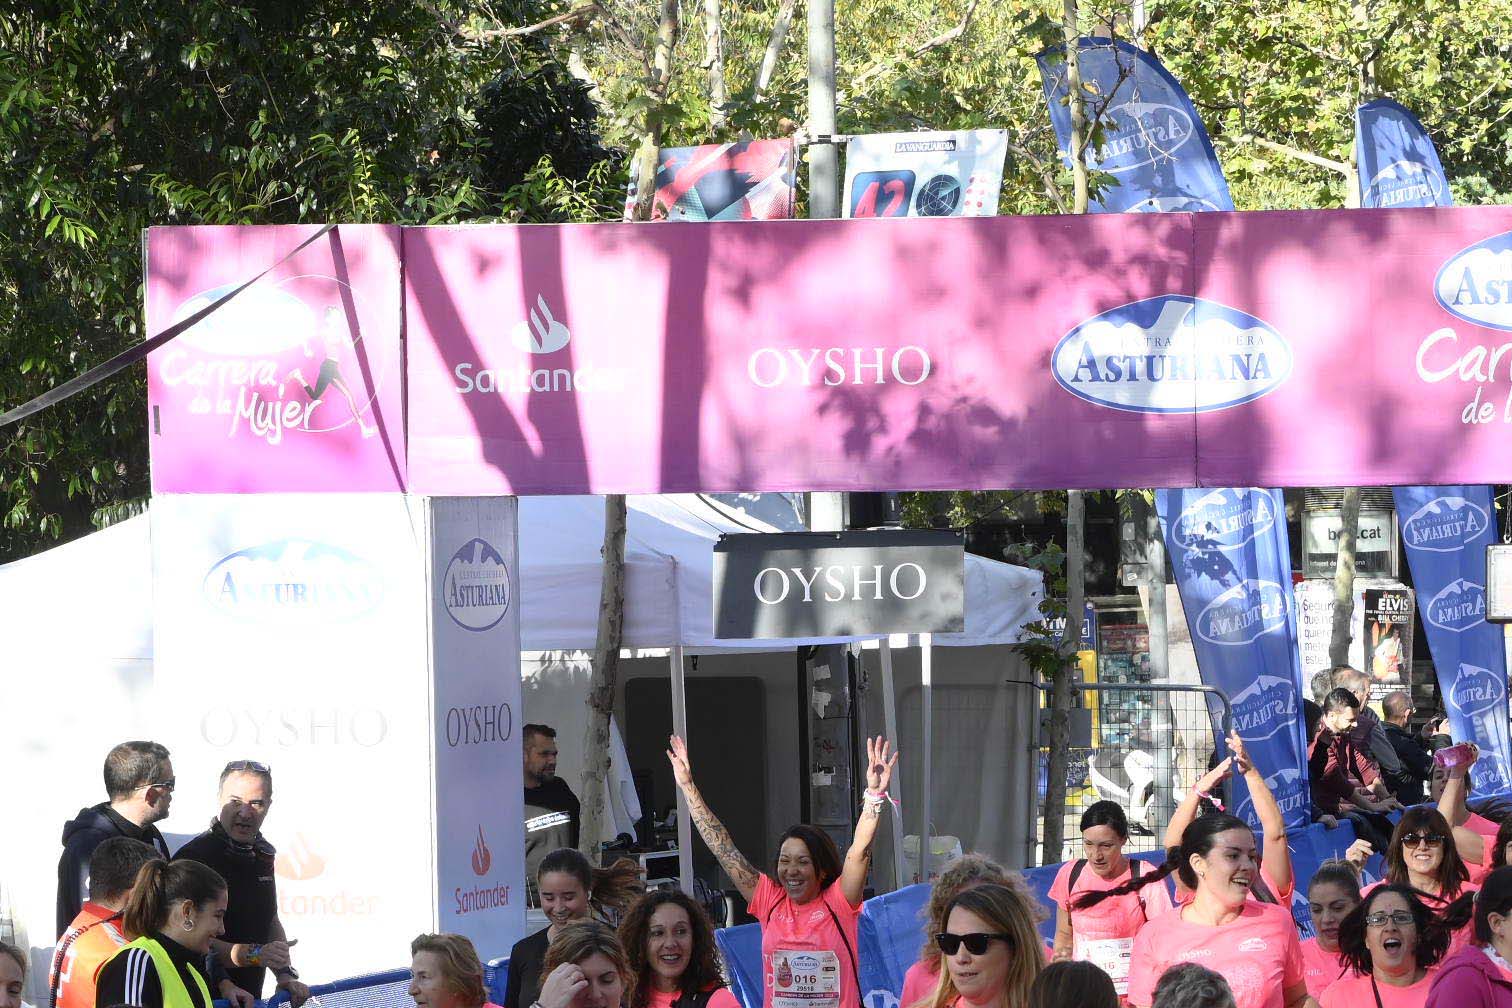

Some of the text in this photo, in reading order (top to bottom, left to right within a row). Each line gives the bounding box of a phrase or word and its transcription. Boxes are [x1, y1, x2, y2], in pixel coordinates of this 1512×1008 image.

[159, 350, 277, 387] Carrera
[747, 345, 931, 387] OYSHO
[228, 382, 322, 445] Mujer
[1461, 385, 1498, 425] de
[448, 571, 507, 608] ASTURIANA
[754, 563, 927, 605] OYSHO
[1378, 598, 1409, 612] ELVIS
[200, 706, 388, 748] OYSHO
[446, 703, 512, 748] OYSHO
[278, 888, 377, 916] tander
[455, 884, 511, 916] Santander
[794, 975, 817, 984] 016
